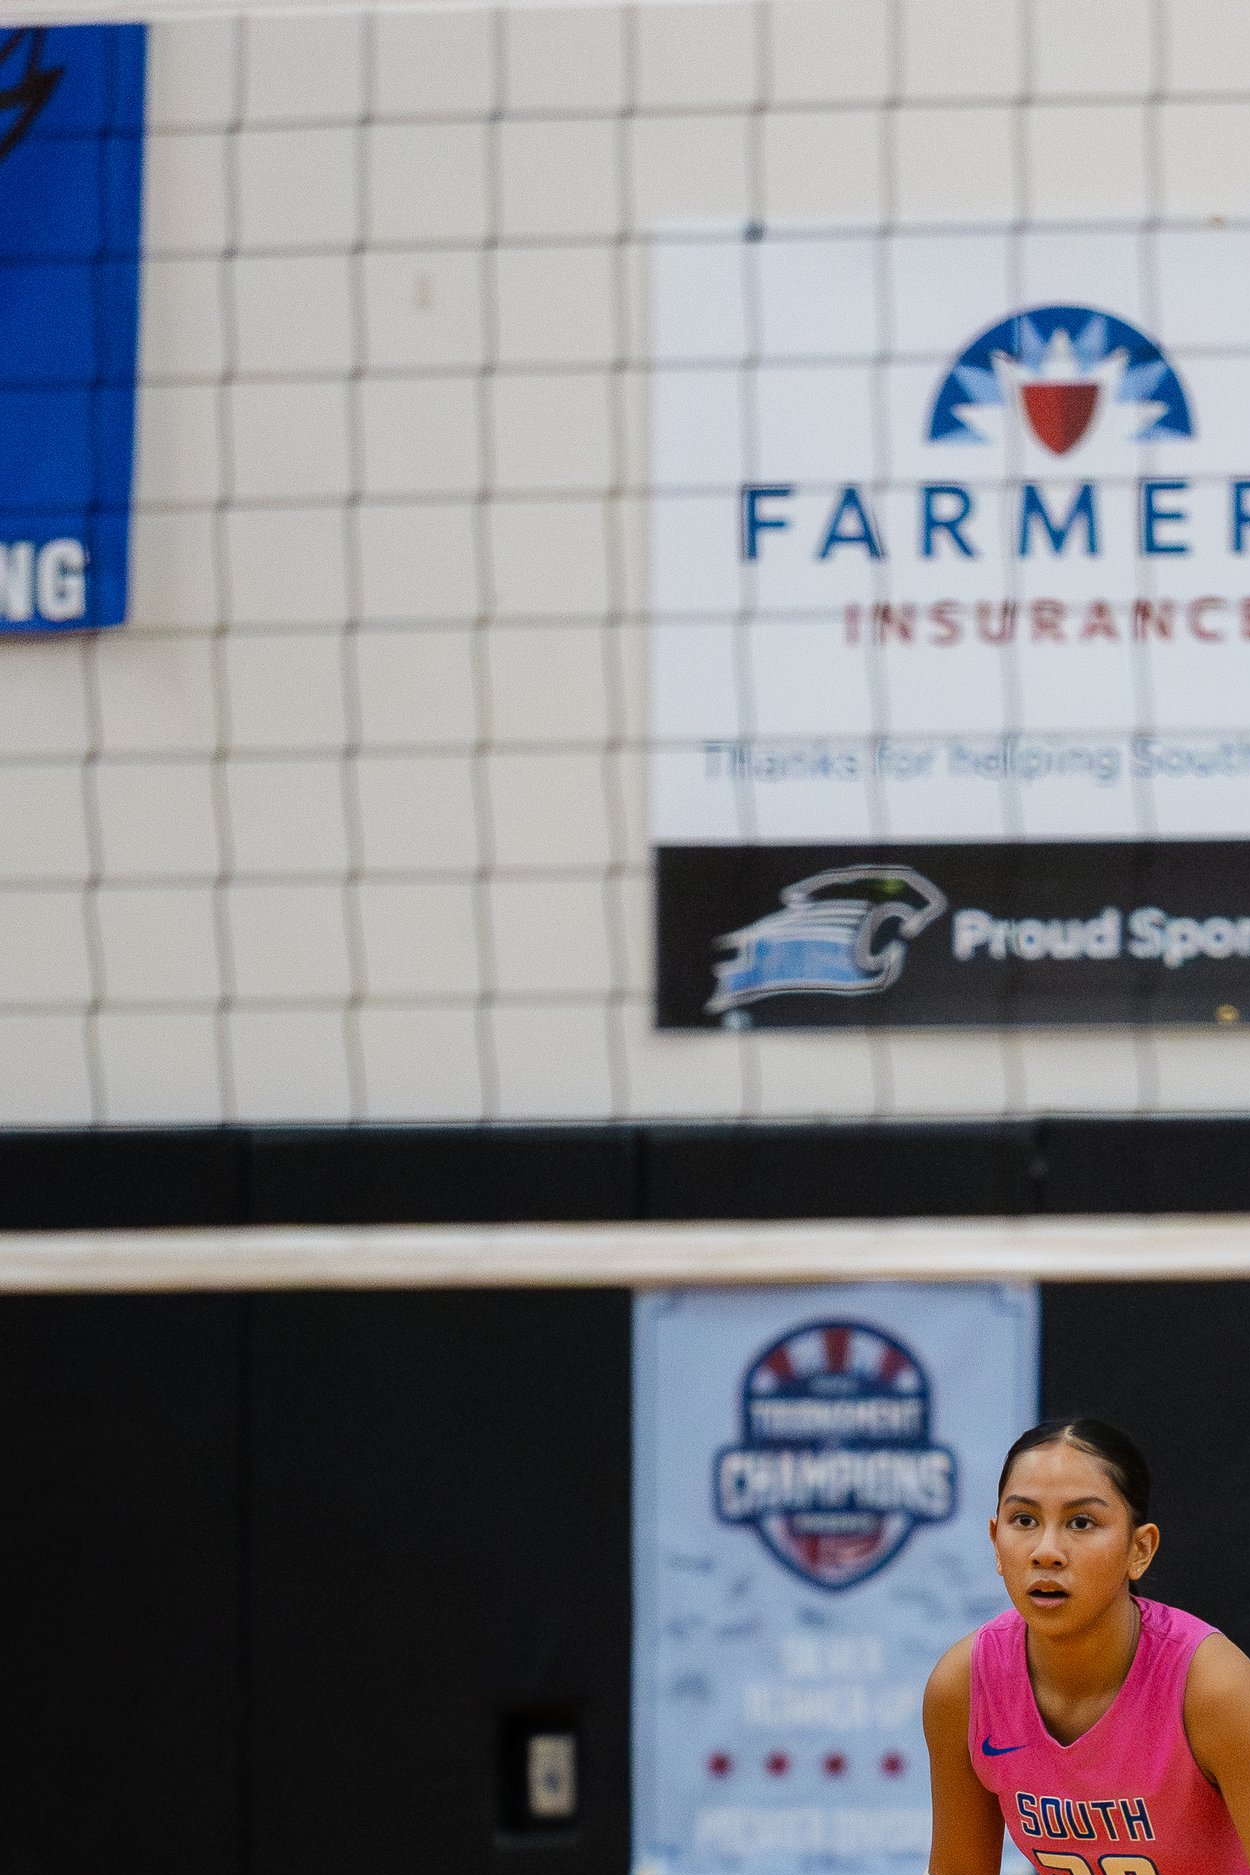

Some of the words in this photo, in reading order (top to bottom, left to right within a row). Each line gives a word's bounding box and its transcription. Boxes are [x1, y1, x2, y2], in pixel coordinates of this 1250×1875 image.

[705, 740, 860, 784] Thanks
[878, 738, 937, 781] for
[949, 736, 1119, 787] helping
[952, 905, 1121, 962] Proud
[1015, 1791, 1156, 1842] SOUTH
